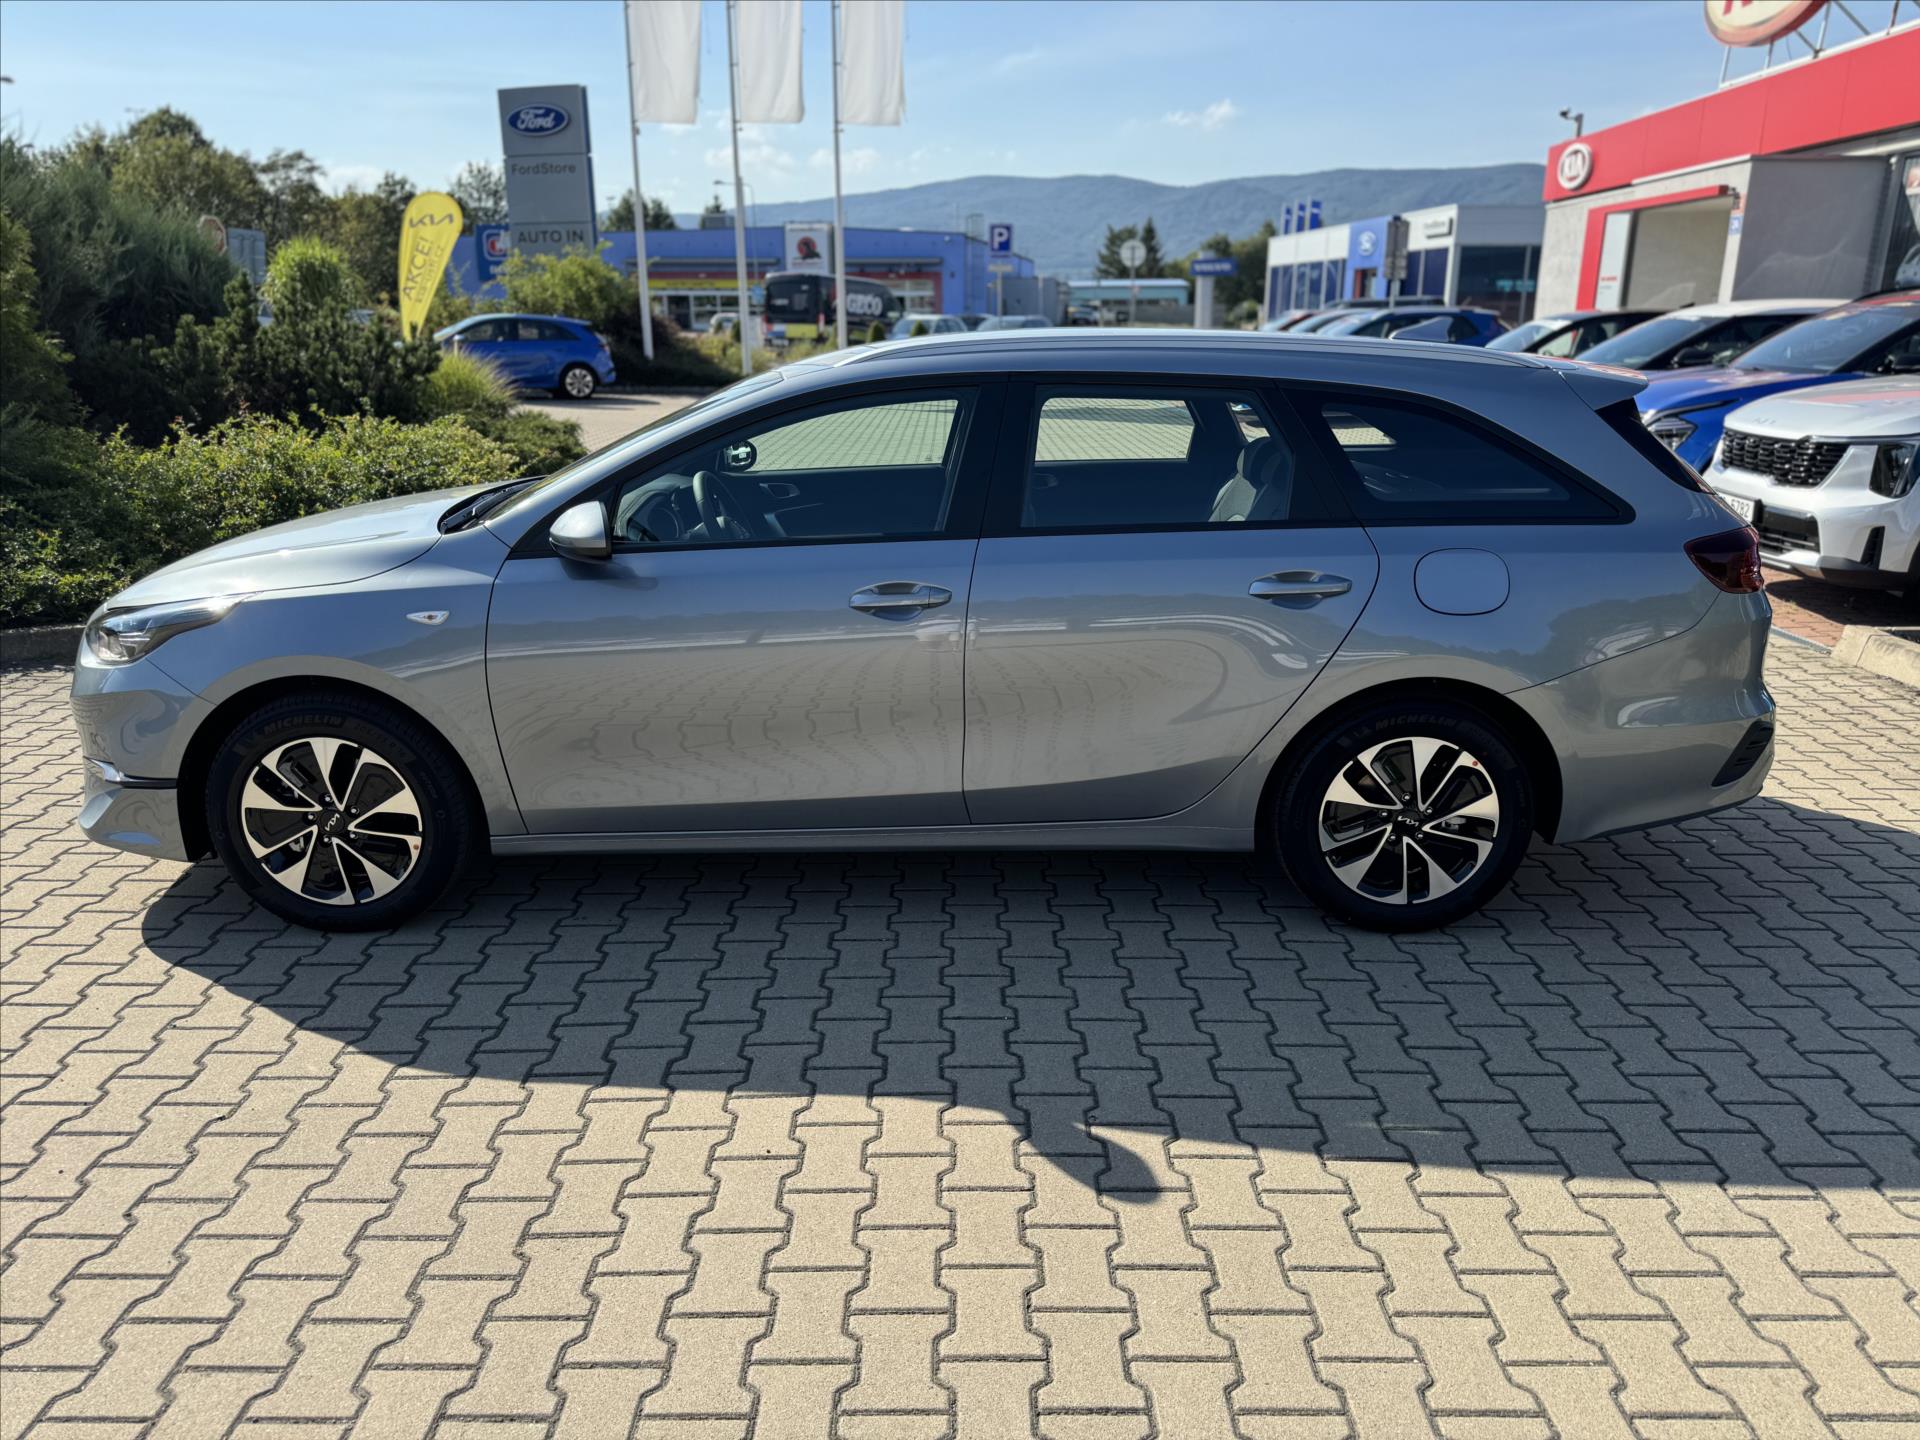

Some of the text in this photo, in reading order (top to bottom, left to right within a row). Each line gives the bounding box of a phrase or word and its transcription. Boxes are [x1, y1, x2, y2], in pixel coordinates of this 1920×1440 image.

[516, 108, 556, 131] Ford
[511, 162, 576, 175] FordStore
[518, 228, 584, 245] AUTO IN
[993, 227, 1009, 250] P
[263, 714, 341, 735] MICHELIN
[1376, 714, 1456, 730] MICHELIN
